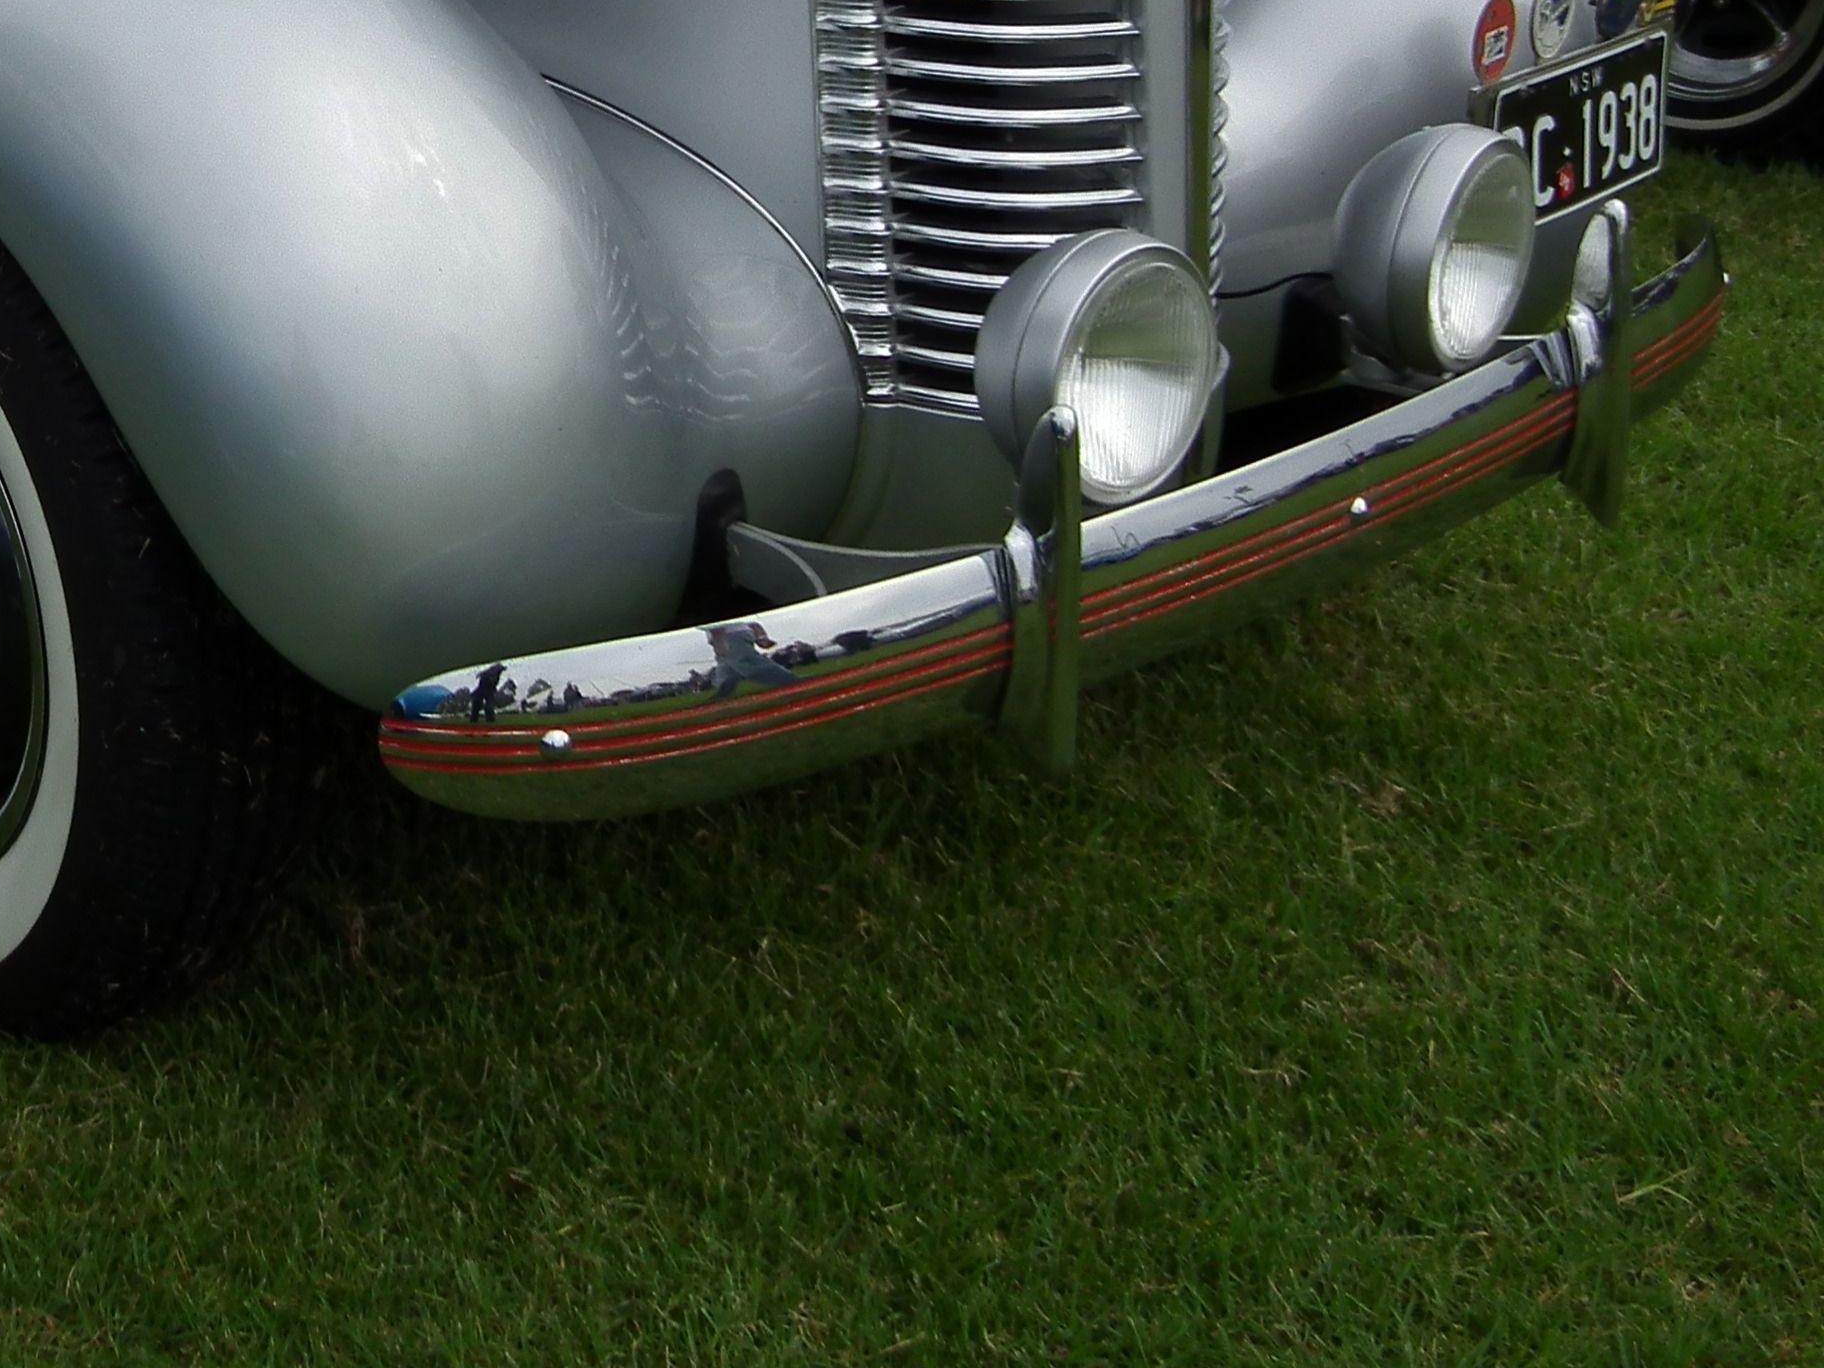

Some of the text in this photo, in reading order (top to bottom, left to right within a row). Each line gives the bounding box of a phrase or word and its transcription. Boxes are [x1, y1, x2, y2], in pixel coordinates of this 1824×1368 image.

[1569, 67, 1603, 95] NSW
[1501, 73, 1658, 208] C 1938
